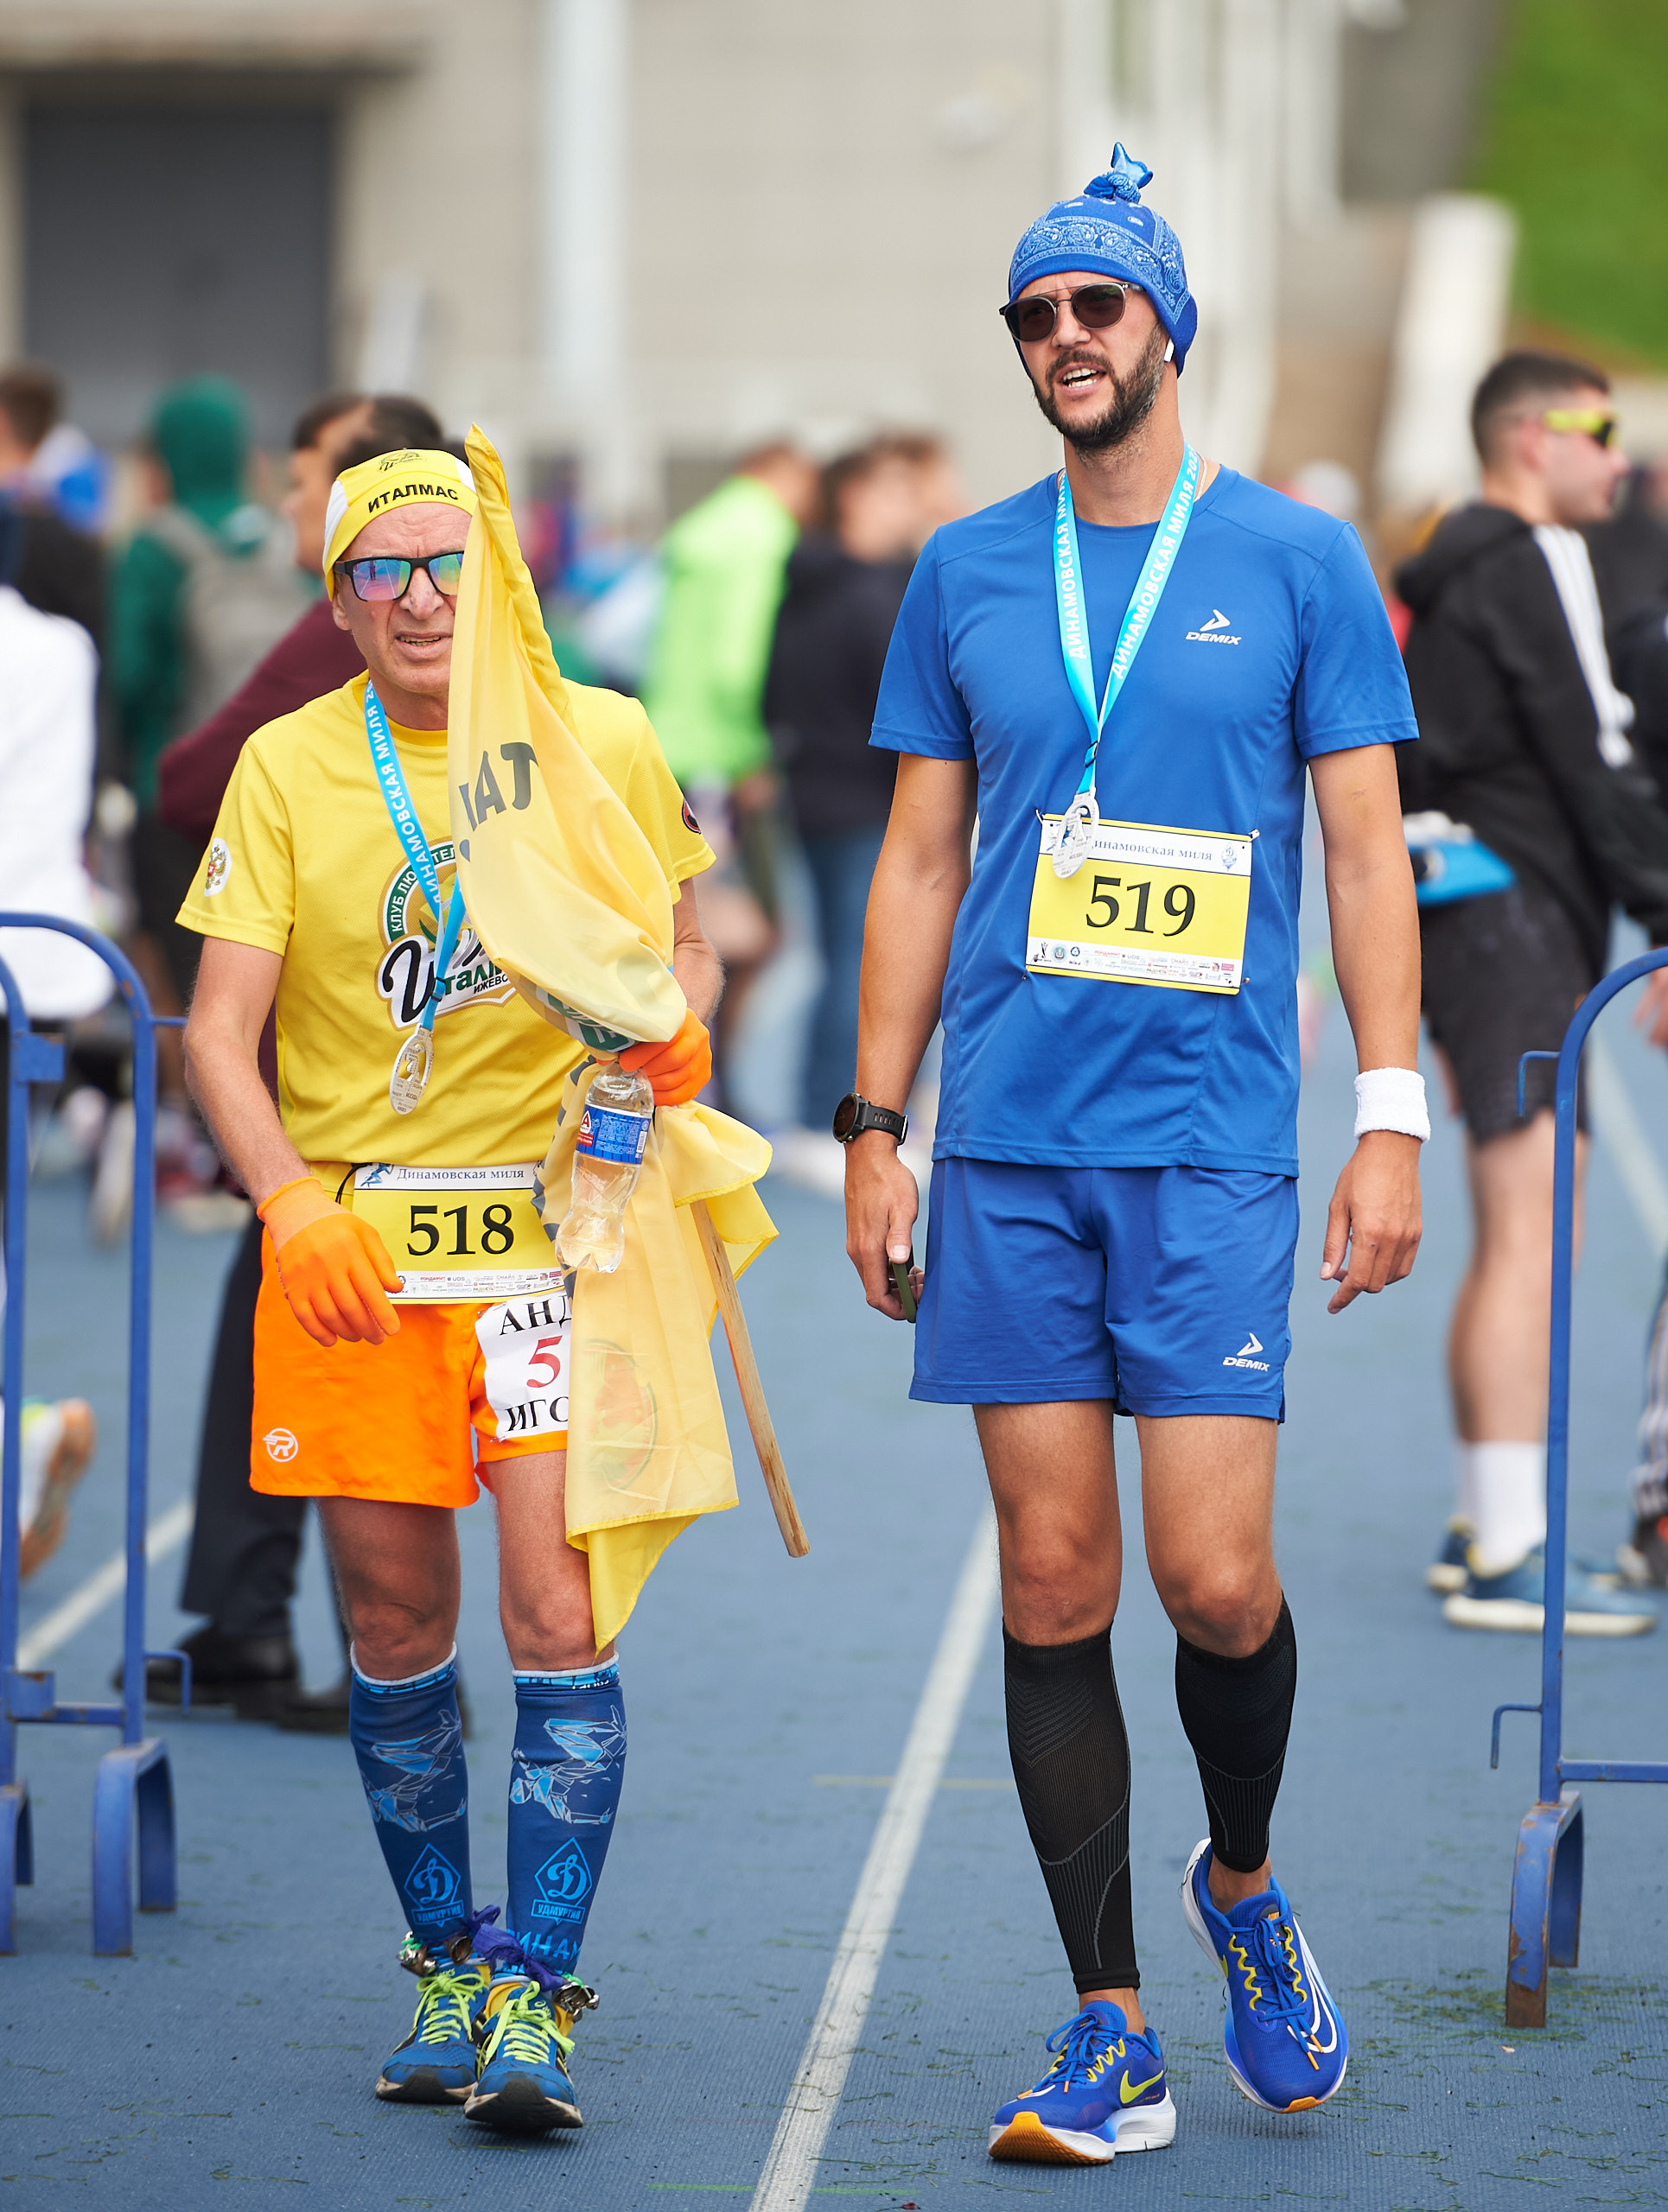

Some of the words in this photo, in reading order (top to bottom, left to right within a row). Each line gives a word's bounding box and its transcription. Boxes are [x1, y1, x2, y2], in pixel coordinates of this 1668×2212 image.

[368, 484, 459, 513] ИТАЛМАС
[1057, 522, 1086, 658] ДИНАМОВСКАЯ
[1111, 536, 1175, 679] ДИНАМОВСКАЯ
[1167, 480, 1194, 534] МИЛЯ
[1185, 632, 1243, 645] DEMIX
[367, 705, 391, 760] МИЛЯ
[1092, 840, 1175, 856] инамовская
[1178, 849, 1213, 861] миля
[391, 895, 404, 932] КЛУБ
[1085, 874, 1196, 937] 519
[474, 974, 508, 994] ИЖЕВС
[397, 1168, 487, 1181] Динамовская
[490, 1169, 525, 1179] миля
[406, 1204, 515, 1256] 518
[526, 1335, 563, 1389] 5
[1222, 1357, 1270, 1372] DEMIX
[417, 1904, 462, 1923] УДМУРТИЯ
[538, 1904, 582, 1920] УДМУРТИЯ
